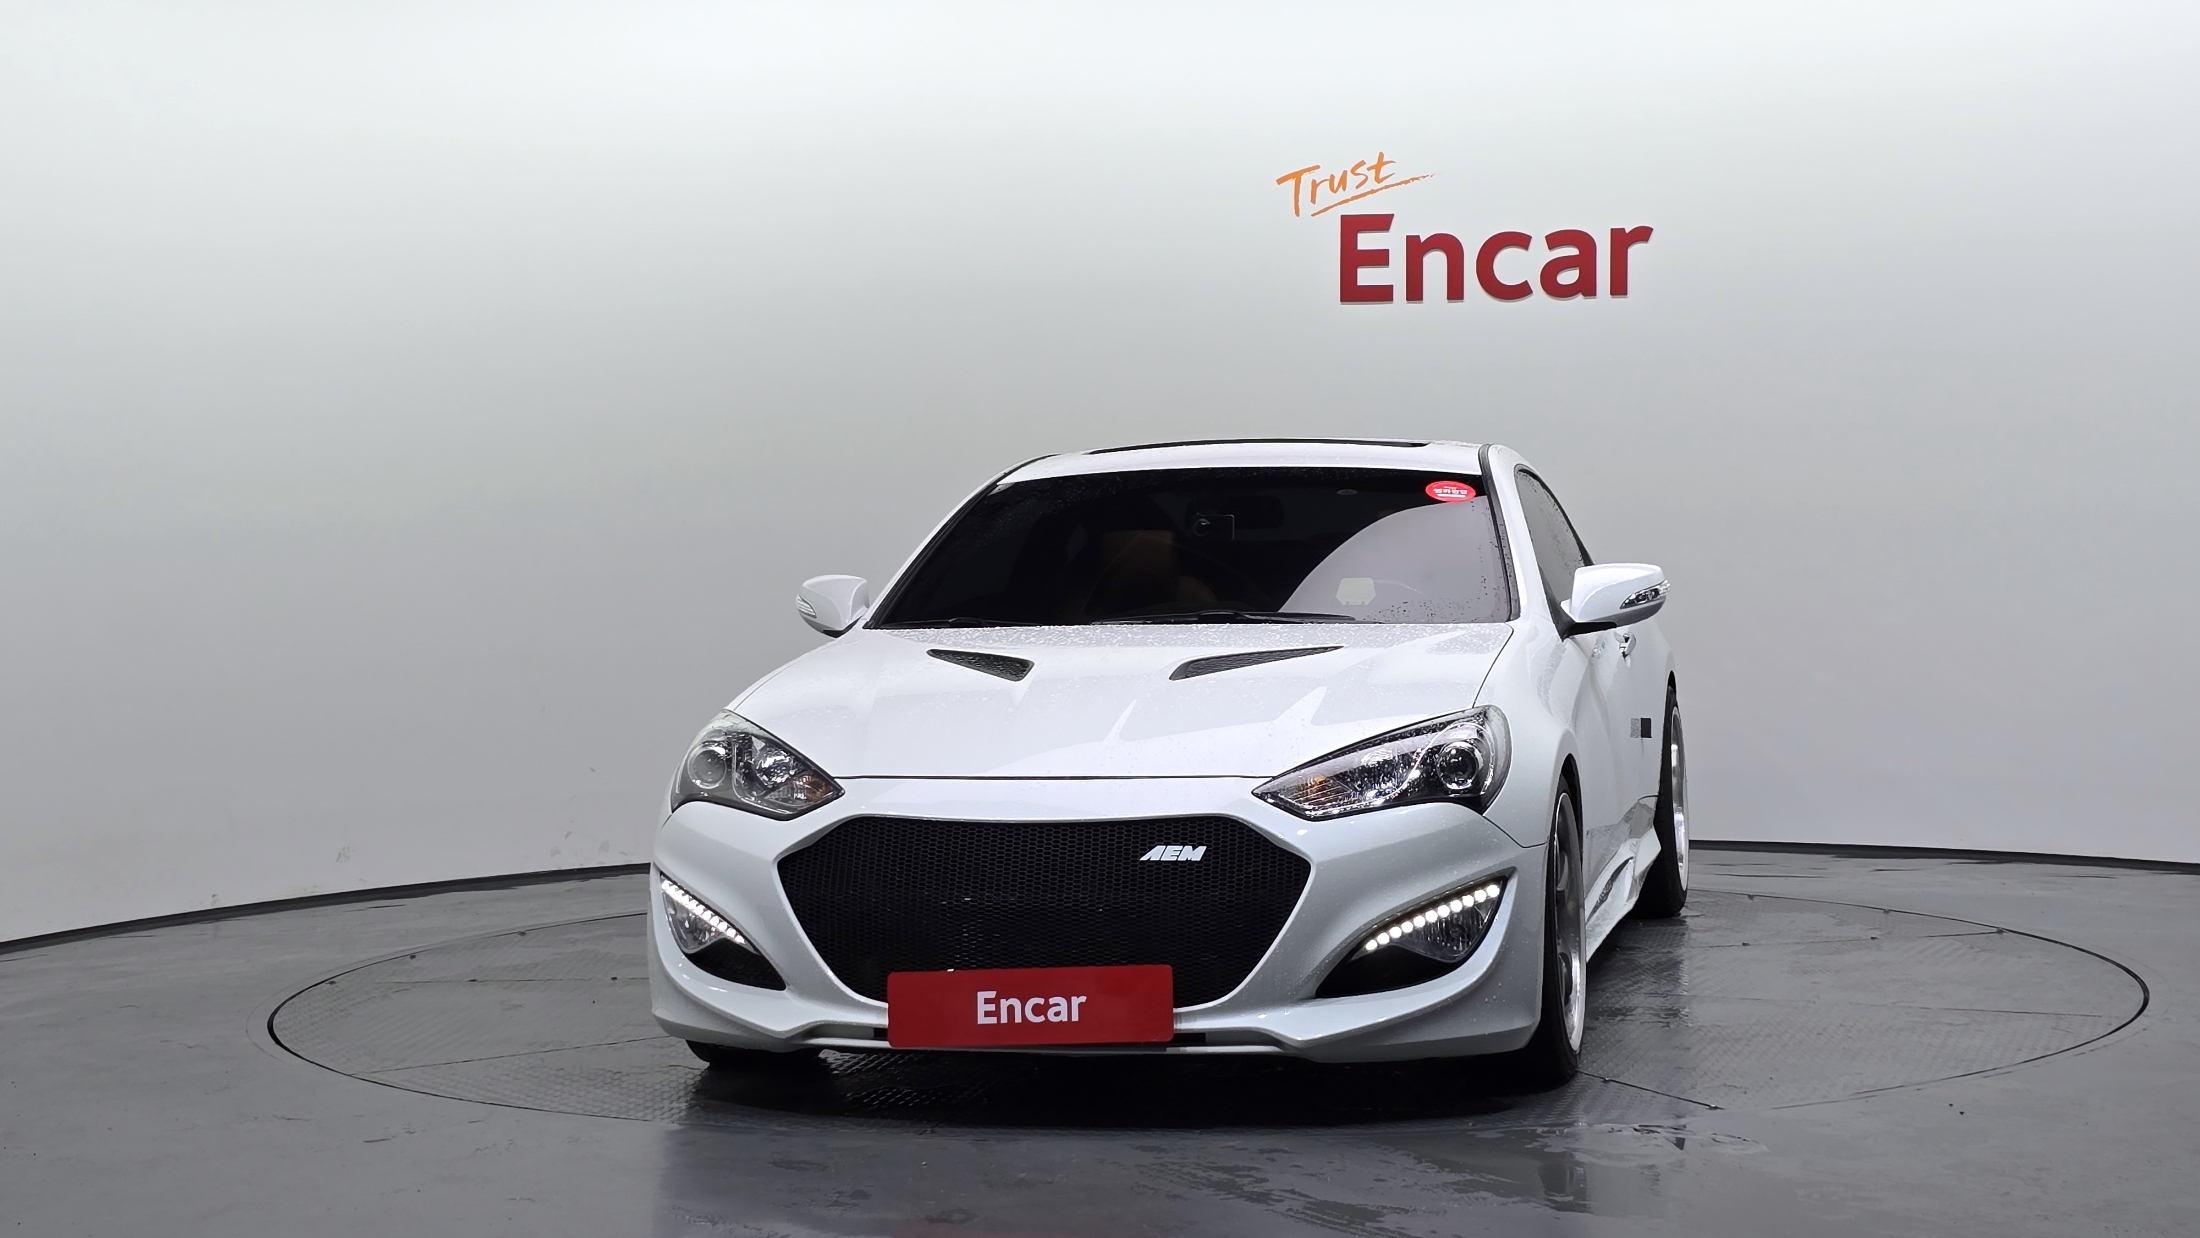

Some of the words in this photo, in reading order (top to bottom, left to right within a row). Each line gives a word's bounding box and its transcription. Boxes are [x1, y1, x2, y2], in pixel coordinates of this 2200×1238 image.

[1276, 151, 1396, 217] Trust
[1340, 213, 1653, 304] Encar
[1140, 845, 1207, 861] AEM
[976, 990, 1087, 1025] Encar
